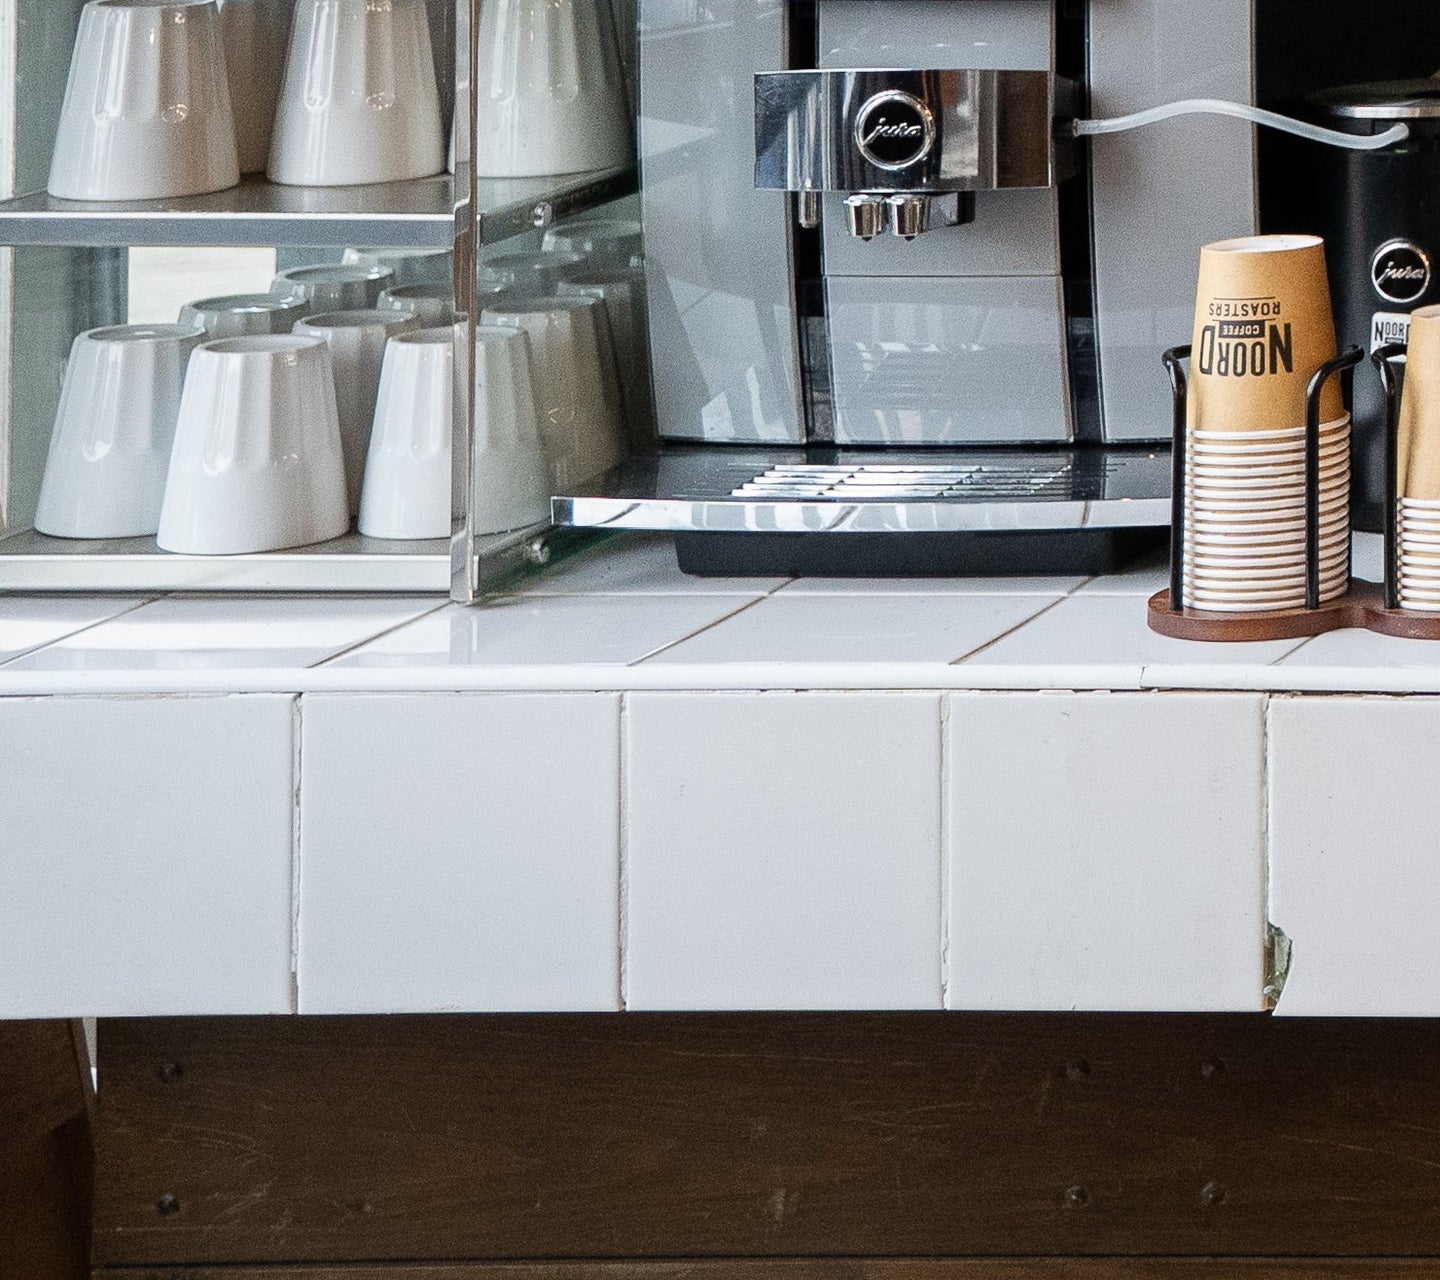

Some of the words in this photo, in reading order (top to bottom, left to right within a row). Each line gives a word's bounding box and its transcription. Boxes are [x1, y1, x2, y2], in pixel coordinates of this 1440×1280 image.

[862, 117, 922, 145] jura
[1377, 261, 1425, 285] jura
[1208, 302, 1281, 317] ROASTERS
[1222, 324, 1260, 335] COFFEE
[1199, 322, 1294, 377] NOORD
